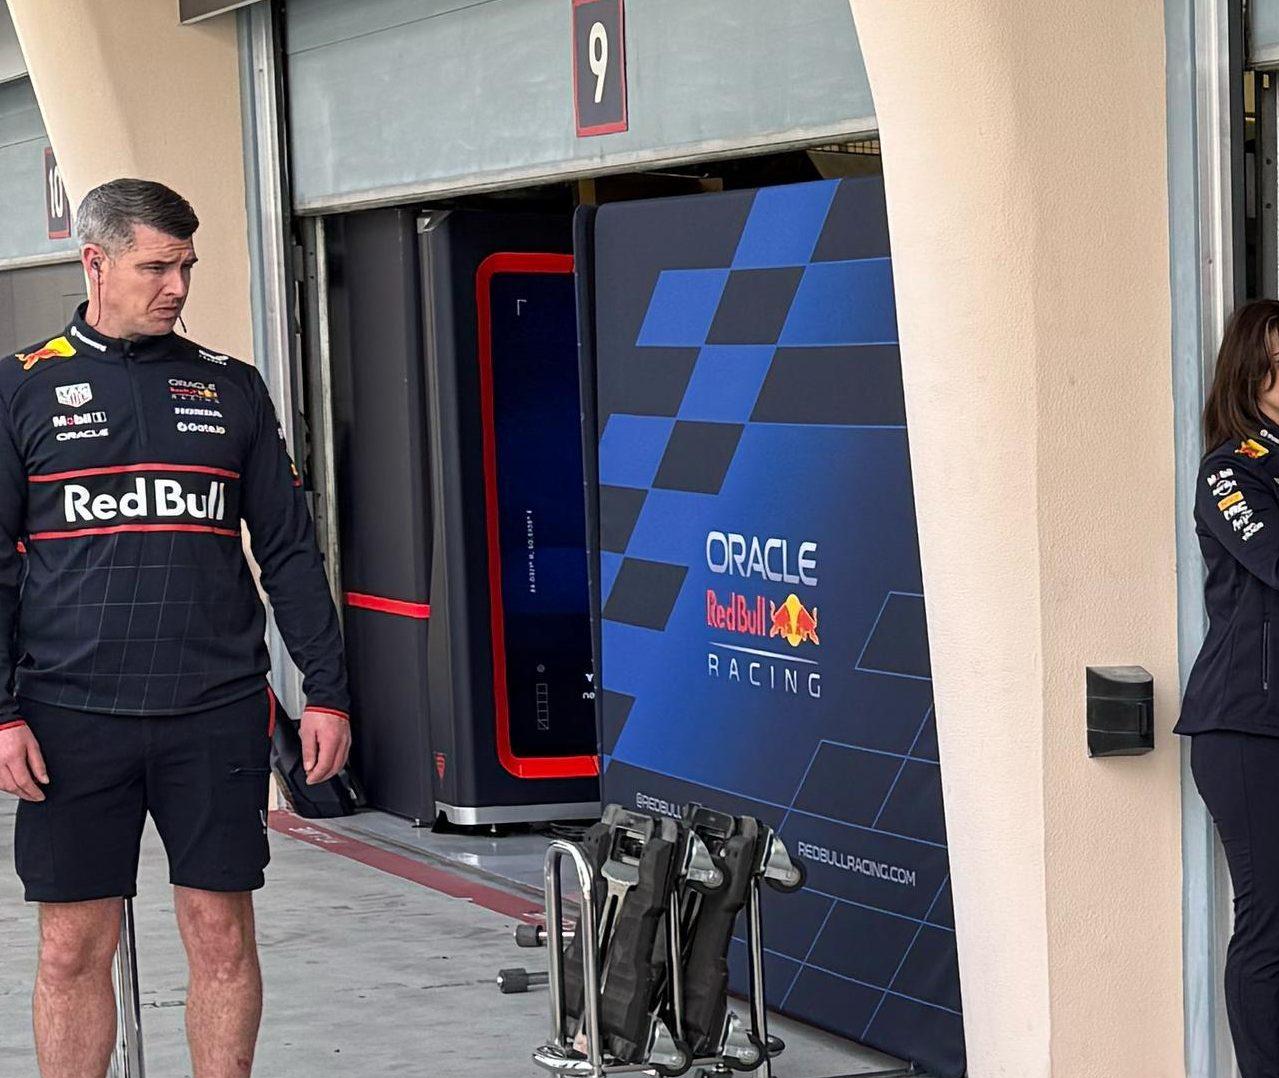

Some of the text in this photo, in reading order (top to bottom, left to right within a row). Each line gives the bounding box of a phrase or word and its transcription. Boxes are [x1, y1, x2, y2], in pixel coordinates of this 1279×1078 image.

[588, 21, 609, 104] 9
[48, 167, 65, 217] 10
[52, 413, 91, 427] Mobil
[56, 428, 109, 442] ORACLE
[174, 407, 223, 418] HONDA
[63, 476, 226, 523] Red Bull
[705, 530, 819, 587] ORACLE
[706, 588, 767, 637] Red Bull
[708, 653, 821, 699] RACING
[797, 841, 916, 887] REDBULLRACING.COM
